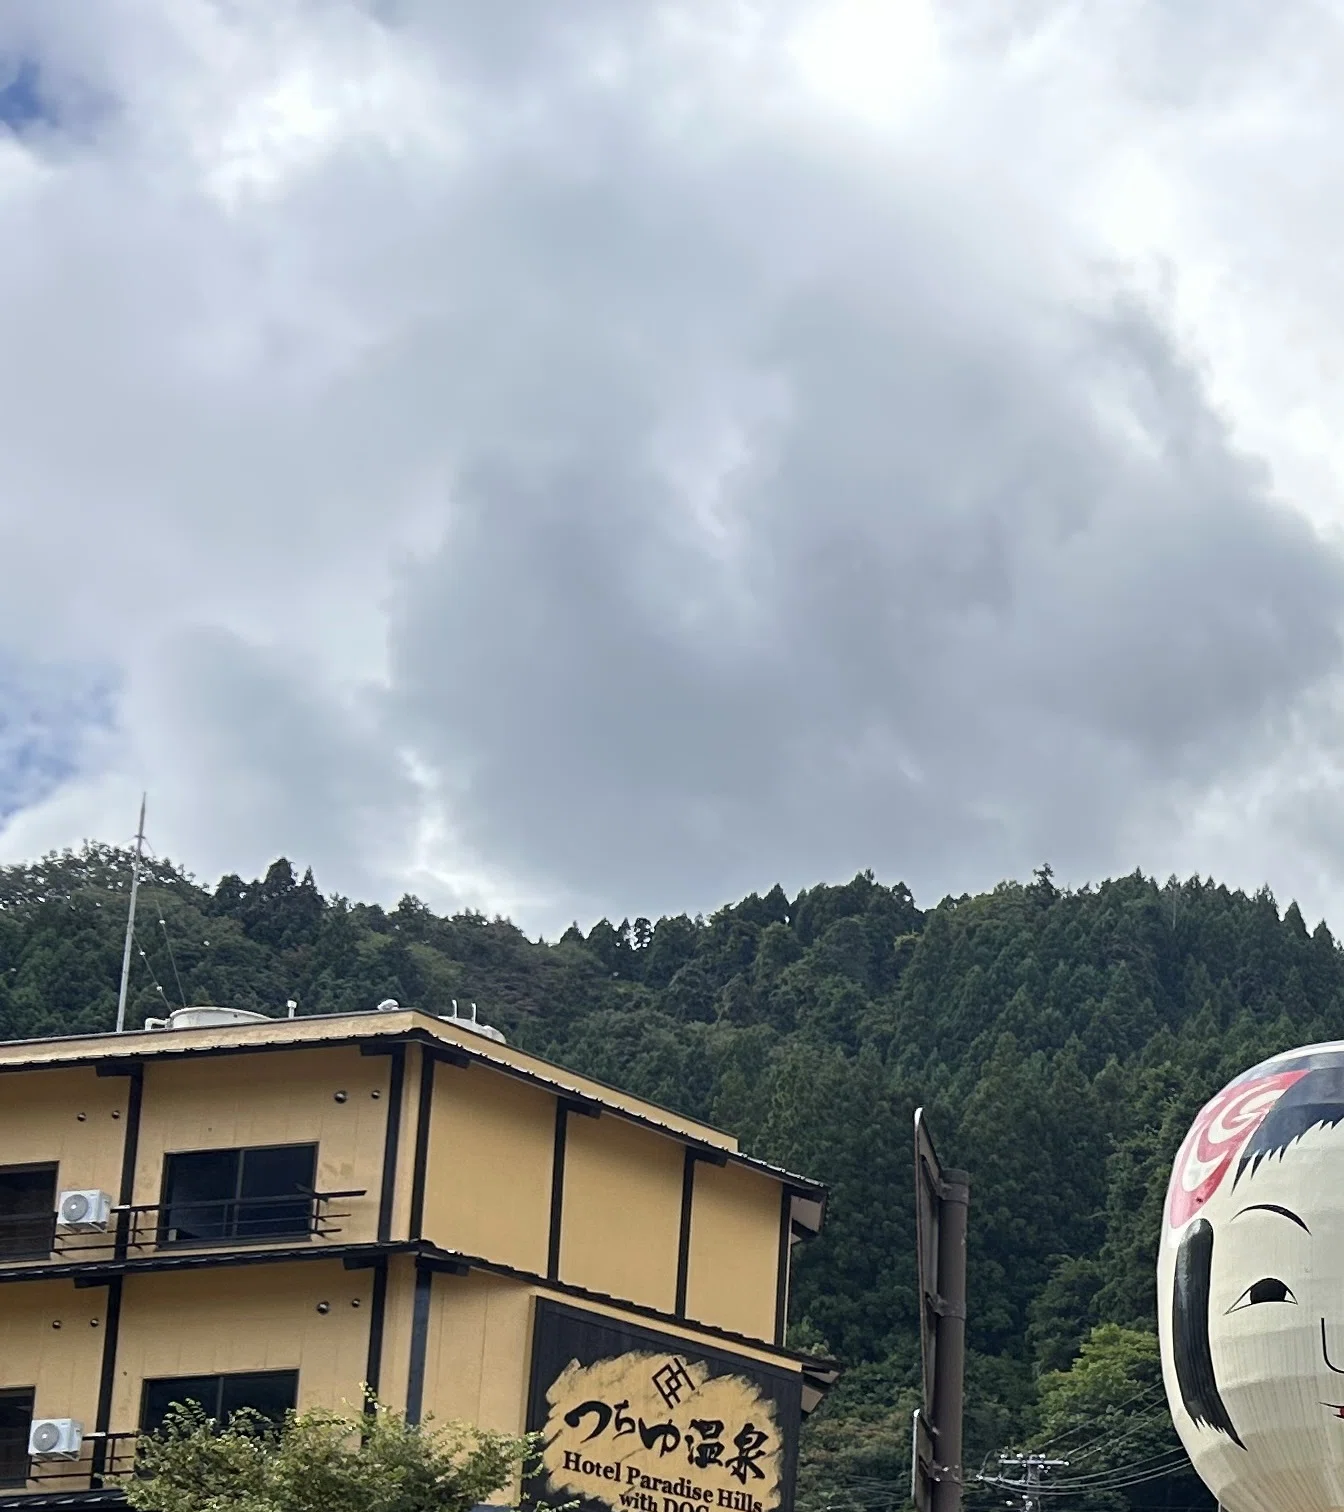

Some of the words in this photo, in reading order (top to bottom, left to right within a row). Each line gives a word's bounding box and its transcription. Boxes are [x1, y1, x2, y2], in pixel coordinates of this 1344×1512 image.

[564, 1399, 770, 1485] つちゆ温泉
[563, 1451, 621, 1482] Hotel
[626, 1465, 714, 1503] Paradise
